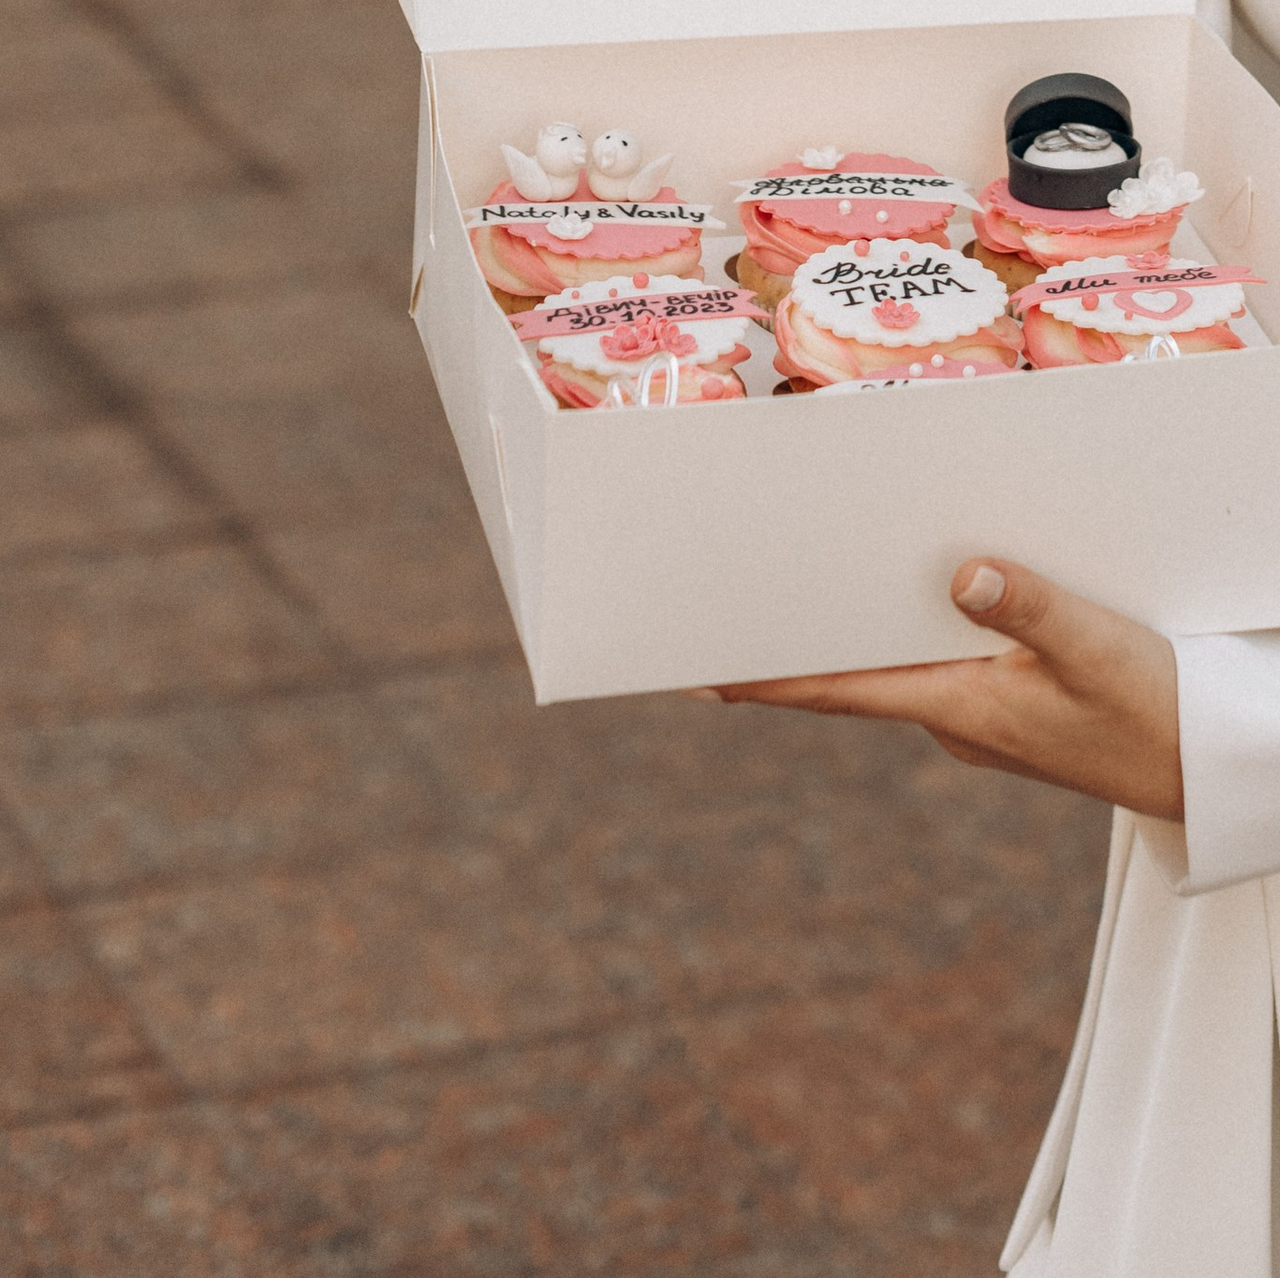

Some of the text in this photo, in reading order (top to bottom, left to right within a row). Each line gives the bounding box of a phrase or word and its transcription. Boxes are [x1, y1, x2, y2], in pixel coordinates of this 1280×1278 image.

[481, 204, 705, 222] Nataly & Vasily
[813, 257, 951, 284] Bride
[1045, 267, 1217, 294] Ми тебе
[829, 277, 976, 307] TEAM
